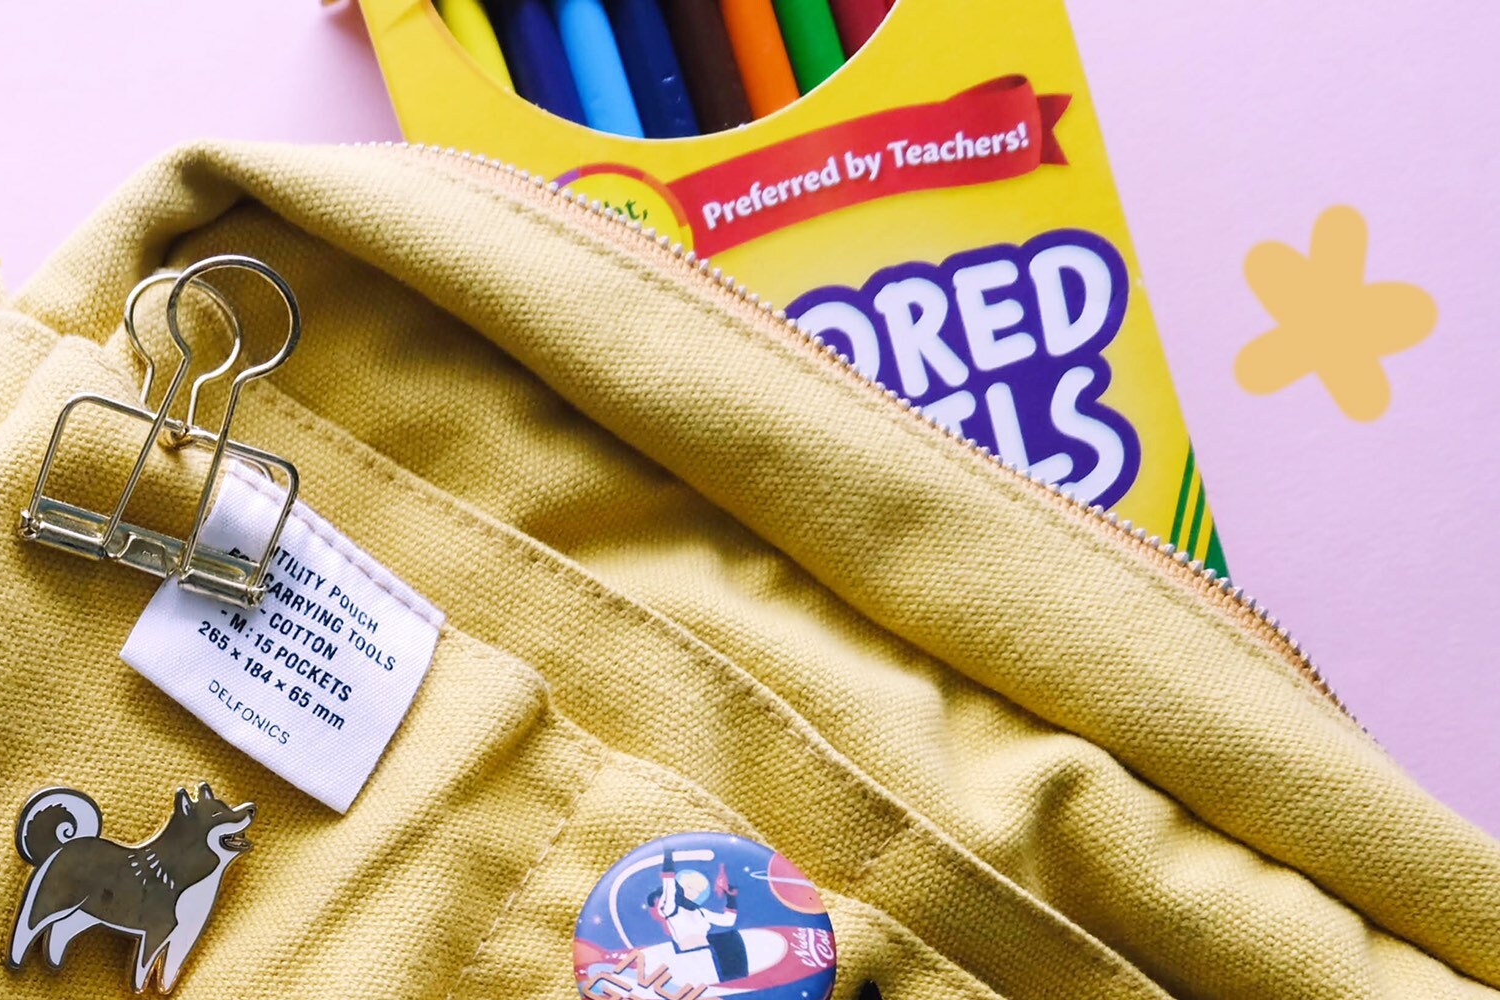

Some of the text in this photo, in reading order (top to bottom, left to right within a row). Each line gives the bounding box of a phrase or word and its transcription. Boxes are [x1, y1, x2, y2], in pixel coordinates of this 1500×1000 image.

[701, 159, 842, 231] Preferred
[845, 148, 881, 184] by
[887, 122, 1030, 170] Teachers!
[263, 571, 397, 673] CARRYING TOOLS
[268, 611, 339, 662] COTTON
[328, 584, 380, 636] POUCH
[197, 620, 232, 652] 265
[242, 657, 274, 685] 184
[288, 685, 313, 710] 65
[312, 702, 347, 732] mm
[253, 632, 276, 655] 15
[273, 645, 353, 704] POCKETS
[208, 678, 291, 746] DELFONICS
